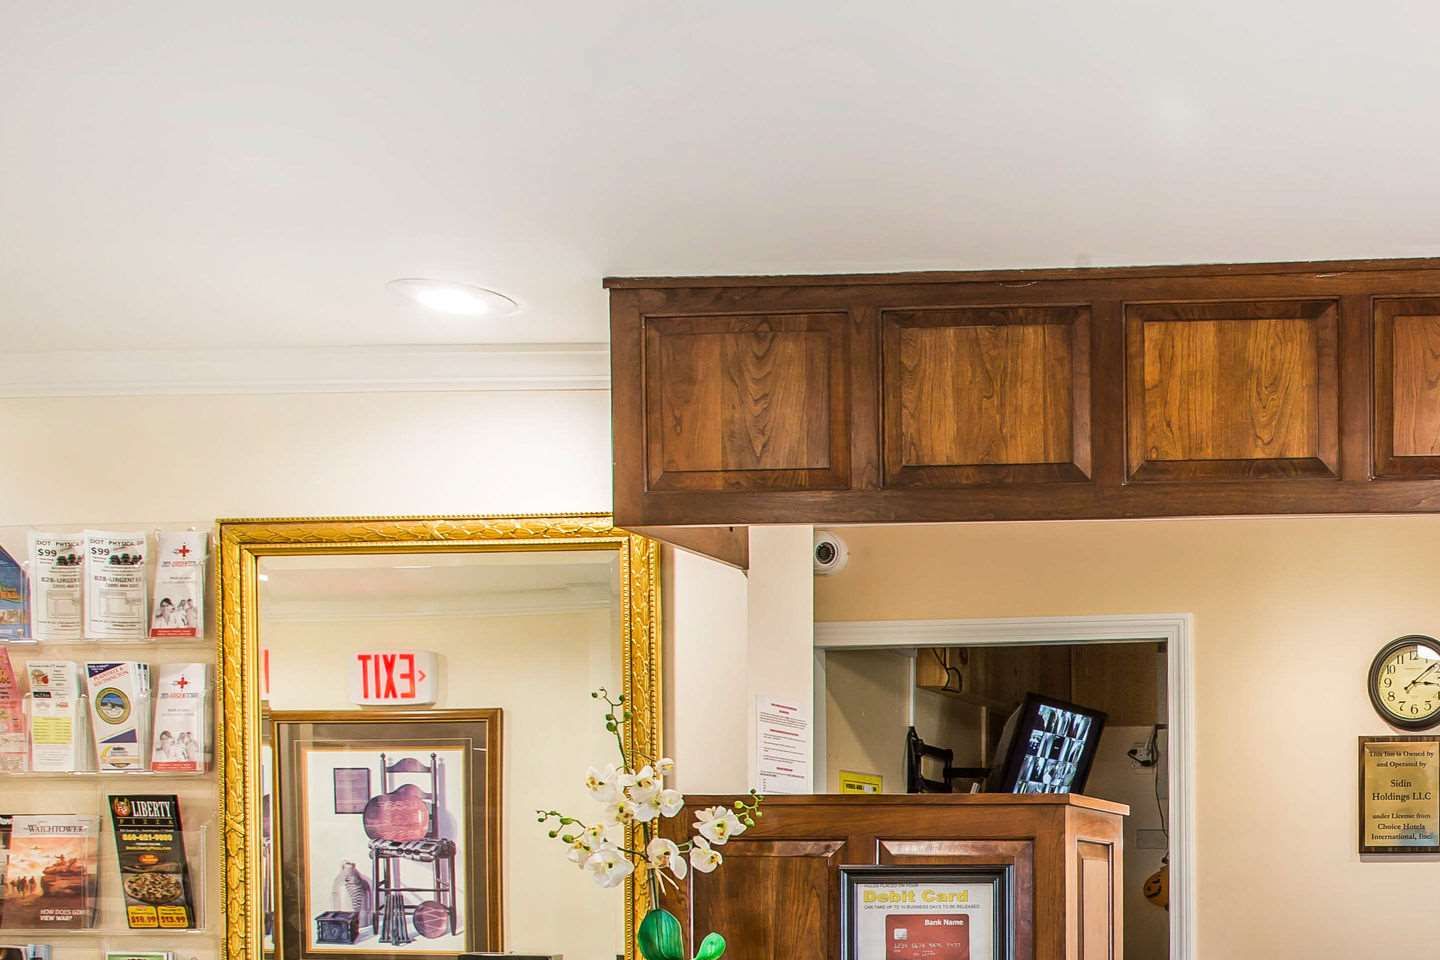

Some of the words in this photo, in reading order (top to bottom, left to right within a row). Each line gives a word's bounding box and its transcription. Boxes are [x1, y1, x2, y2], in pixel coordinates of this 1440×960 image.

[37, 548, 57, 557] $99
[91, 546, 111, 556] $99
[1396, 655, 1404, 664] 11
[1386, 664, 1396, 675] 10
[1434, 663, 1440, 673] 2
[1384, 678, 1392, 688] 9
[1387, 691, 1396, 701] 8
[1398, 701, 1407, 711] 7
[1410, 704, 1419, 714] 6
[1423, 701, 1432, 711] 5
[1426, 751, 1434, 759] by
[1390, 779, 1412, 788] Sidin
[1372, 792, 1410, 802] Holdings
[1412, 792, 1432, 800] LLC
[131, 800, 171, 817] LIBERTY
[1371, 833, 1417, 841] International,
[863, 889, 916, 902] Debit
[921, 888, 969, 902] Card
